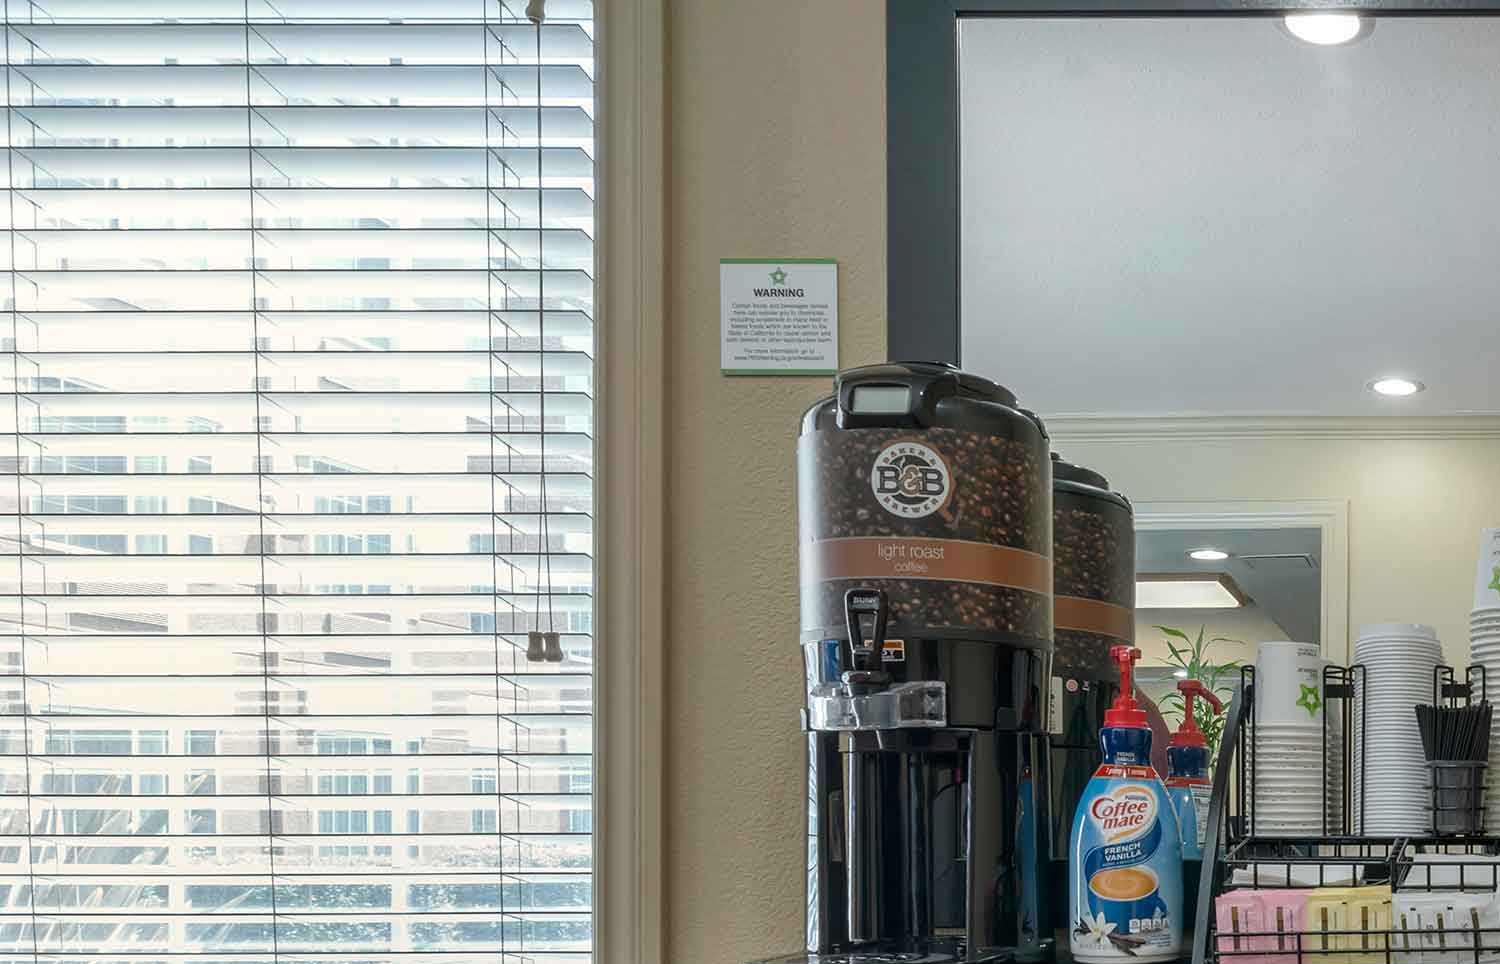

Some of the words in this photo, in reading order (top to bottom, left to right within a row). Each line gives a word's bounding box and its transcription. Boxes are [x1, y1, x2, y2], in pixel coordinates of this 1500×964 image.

[753, 288, 805, 298] WARNING
[876, 466, 944, 496] B&B
[878, 543, 905, 560] light
[910, 544, 945, 559] roast
[894, 561, 928, 573] coffee
[1092, 797, 1149, 820] Coffee
[1104, 814, 1144, 829] mate
[1104, 842, 1141, 854] FRENCH
[1105, 850, 1142, 862] VANILLA
